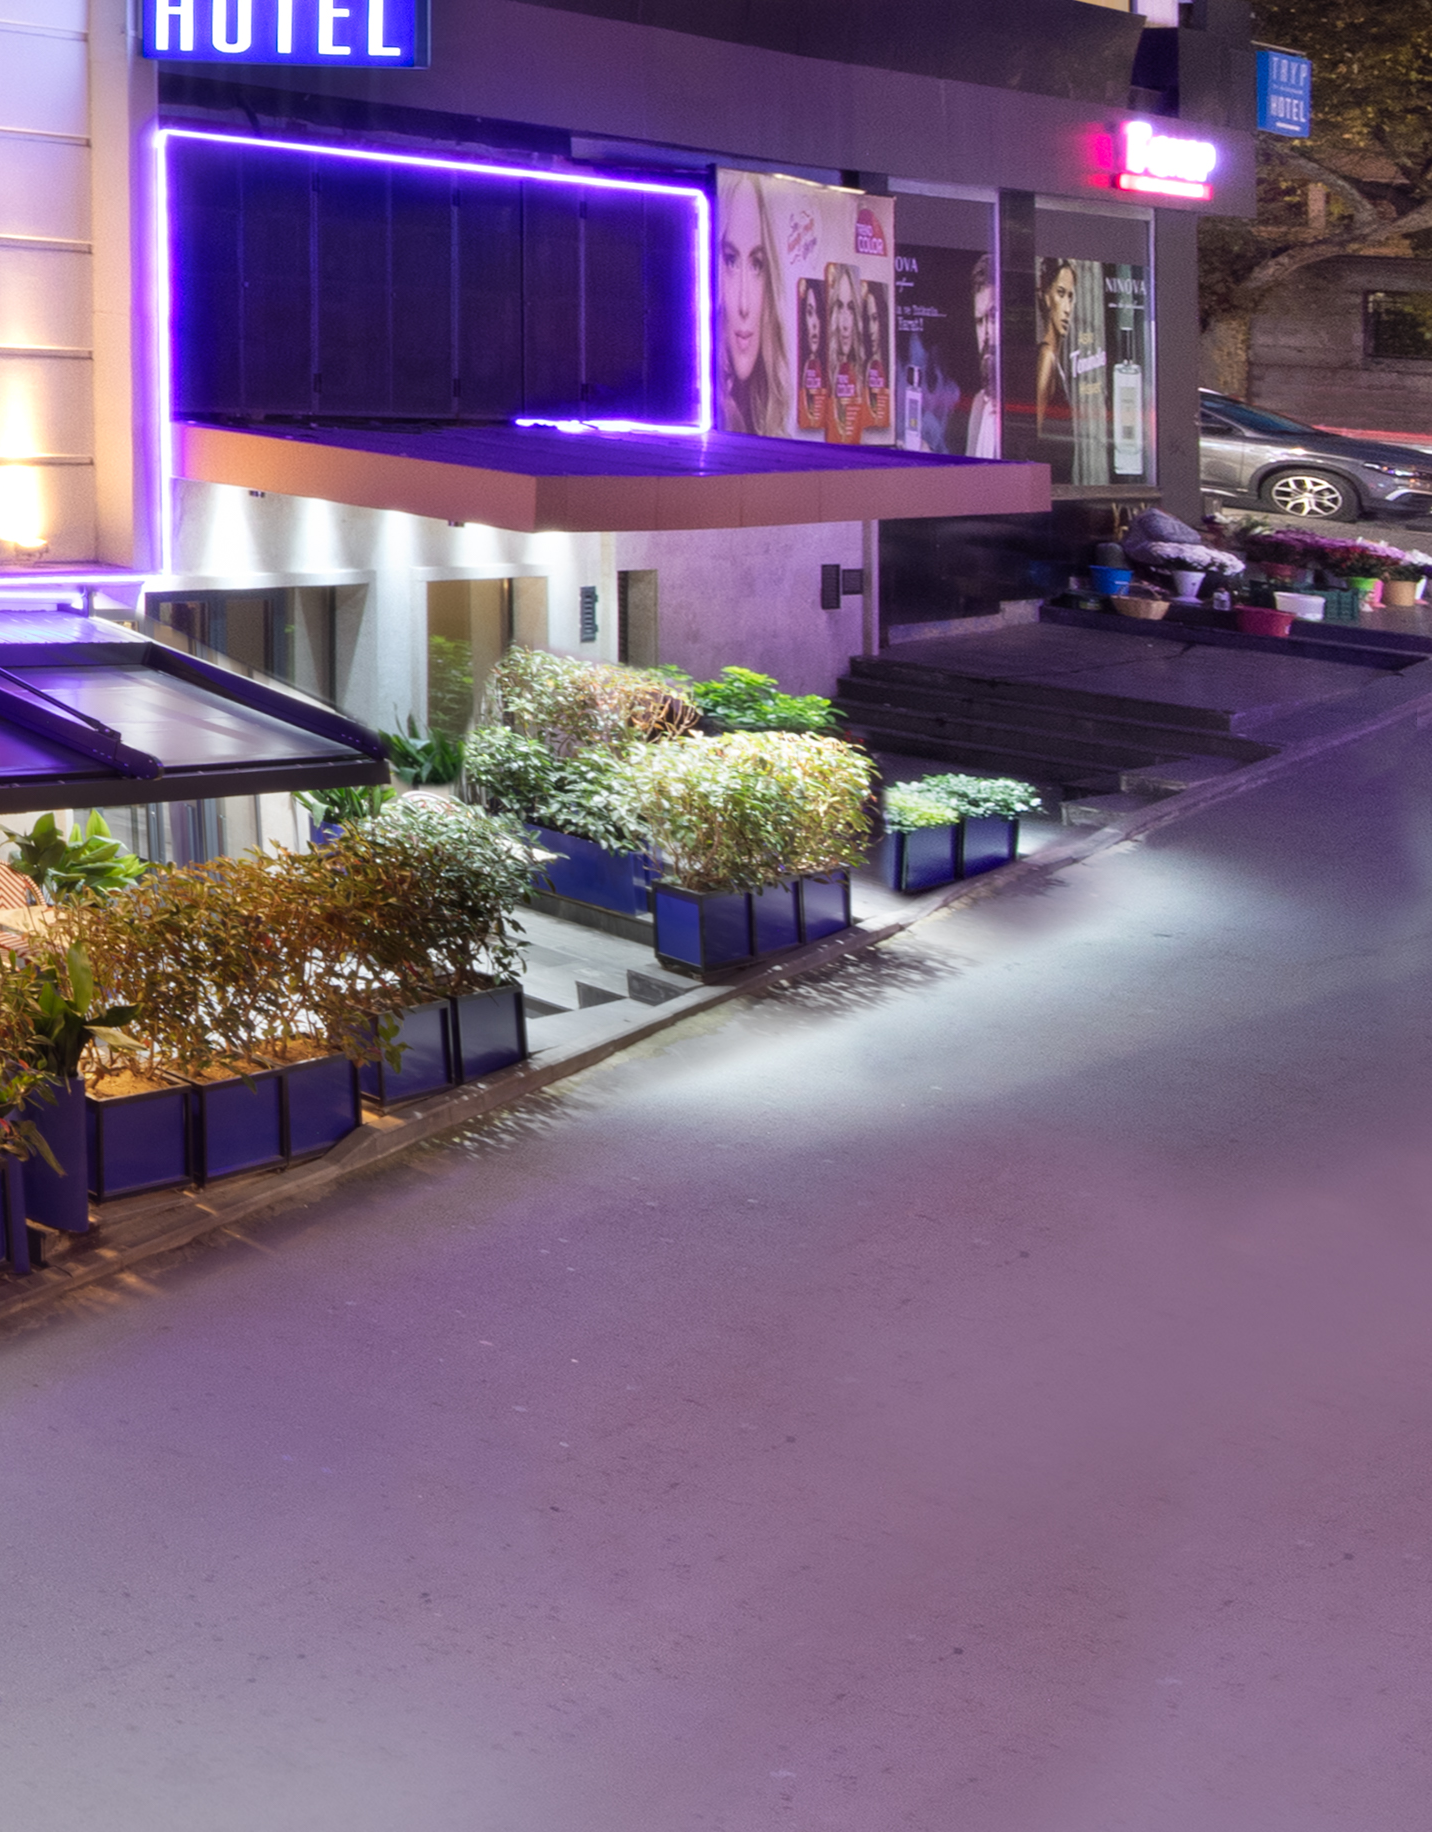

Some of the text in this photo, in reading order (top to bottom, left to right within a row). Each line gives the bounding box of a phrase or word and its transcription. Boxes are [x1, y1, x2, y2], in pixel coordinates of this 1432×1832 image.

[1271, 57, 1309, 87] TRYP
[1269, 94, 1307, 123] HOTEL
[857, 236, 884, 255] COLOR
[1105, 277, 1147, 295] NINOVA
